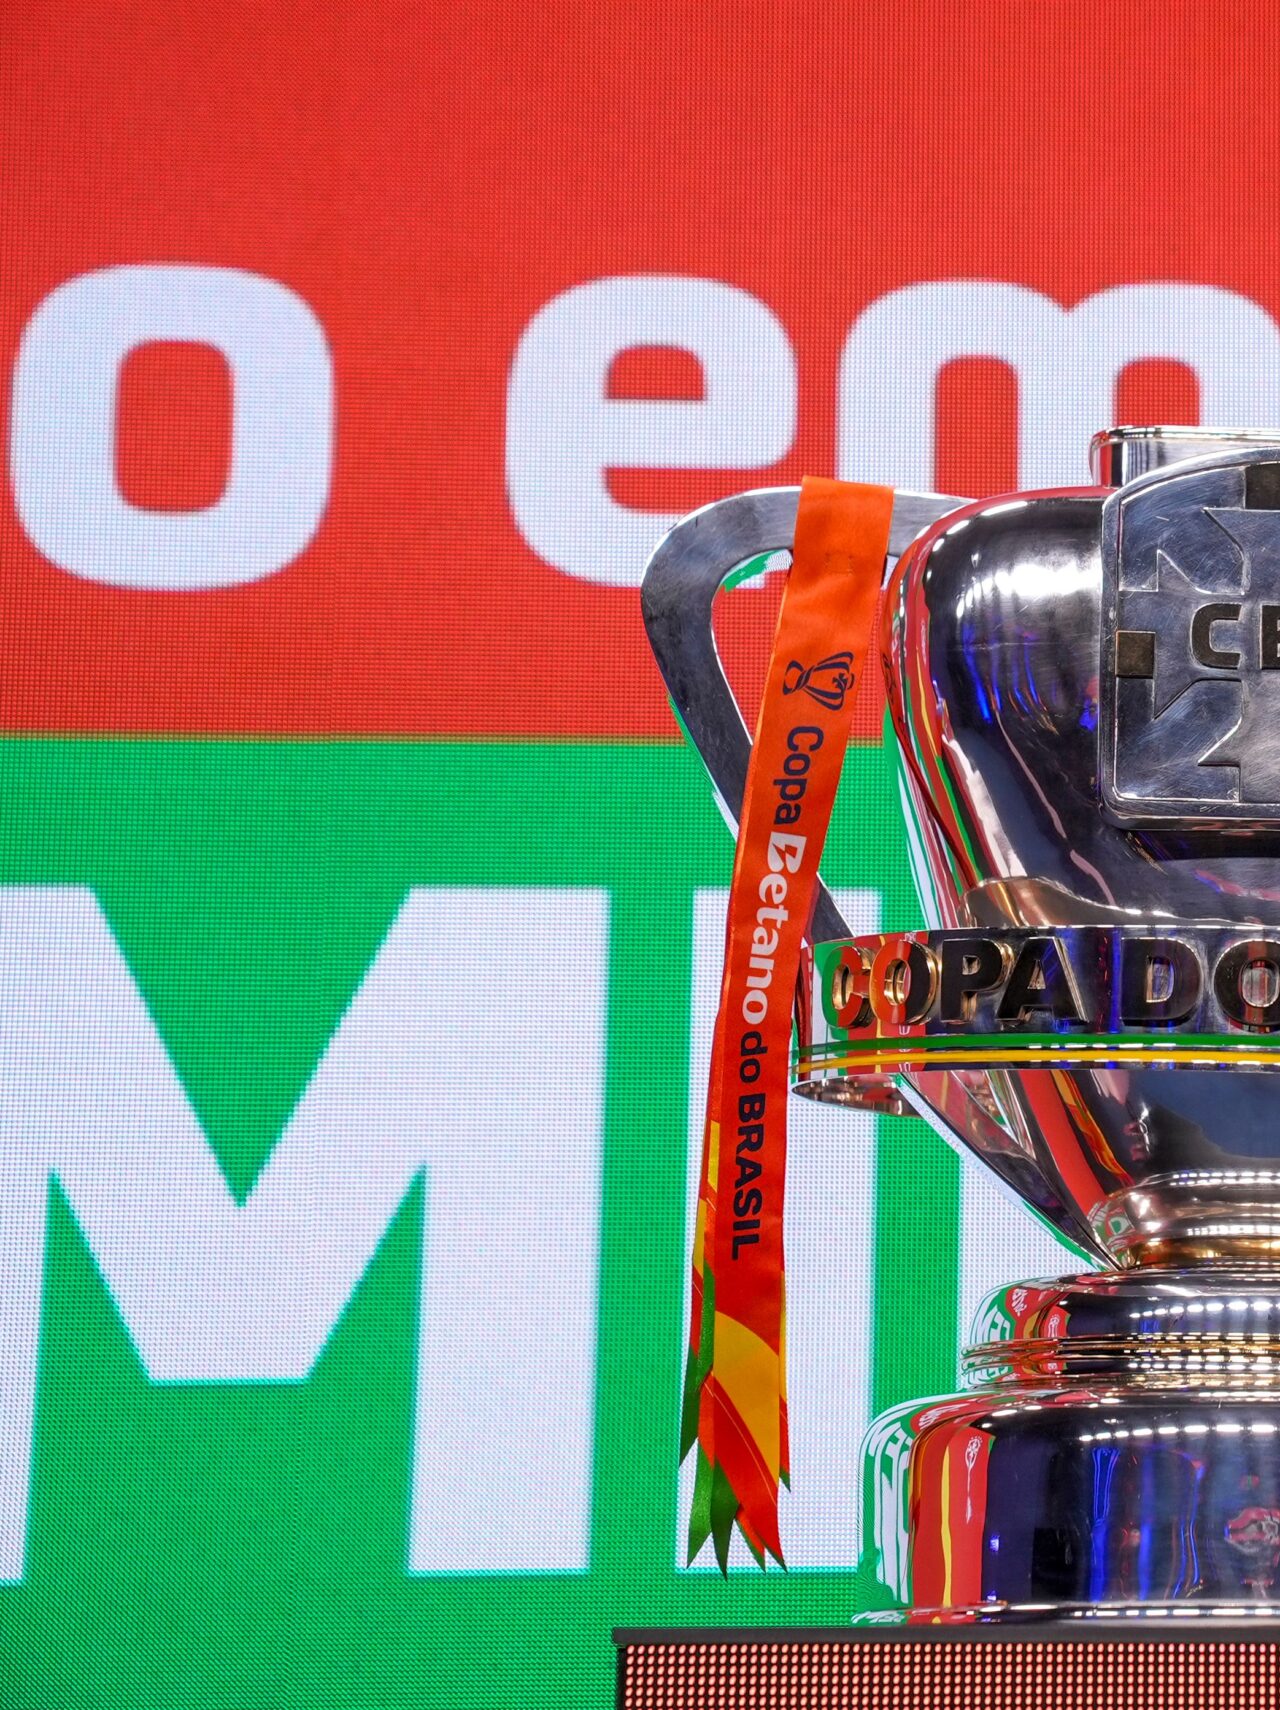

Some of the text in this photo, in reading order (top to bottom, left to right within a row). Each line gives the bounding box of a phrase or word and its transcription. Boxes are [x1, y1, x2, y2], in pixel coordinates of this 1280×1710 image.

[731, 725, 825, 1261] Copa Betano do BRASIL
[820, 934, 1090, 1030] COPA
